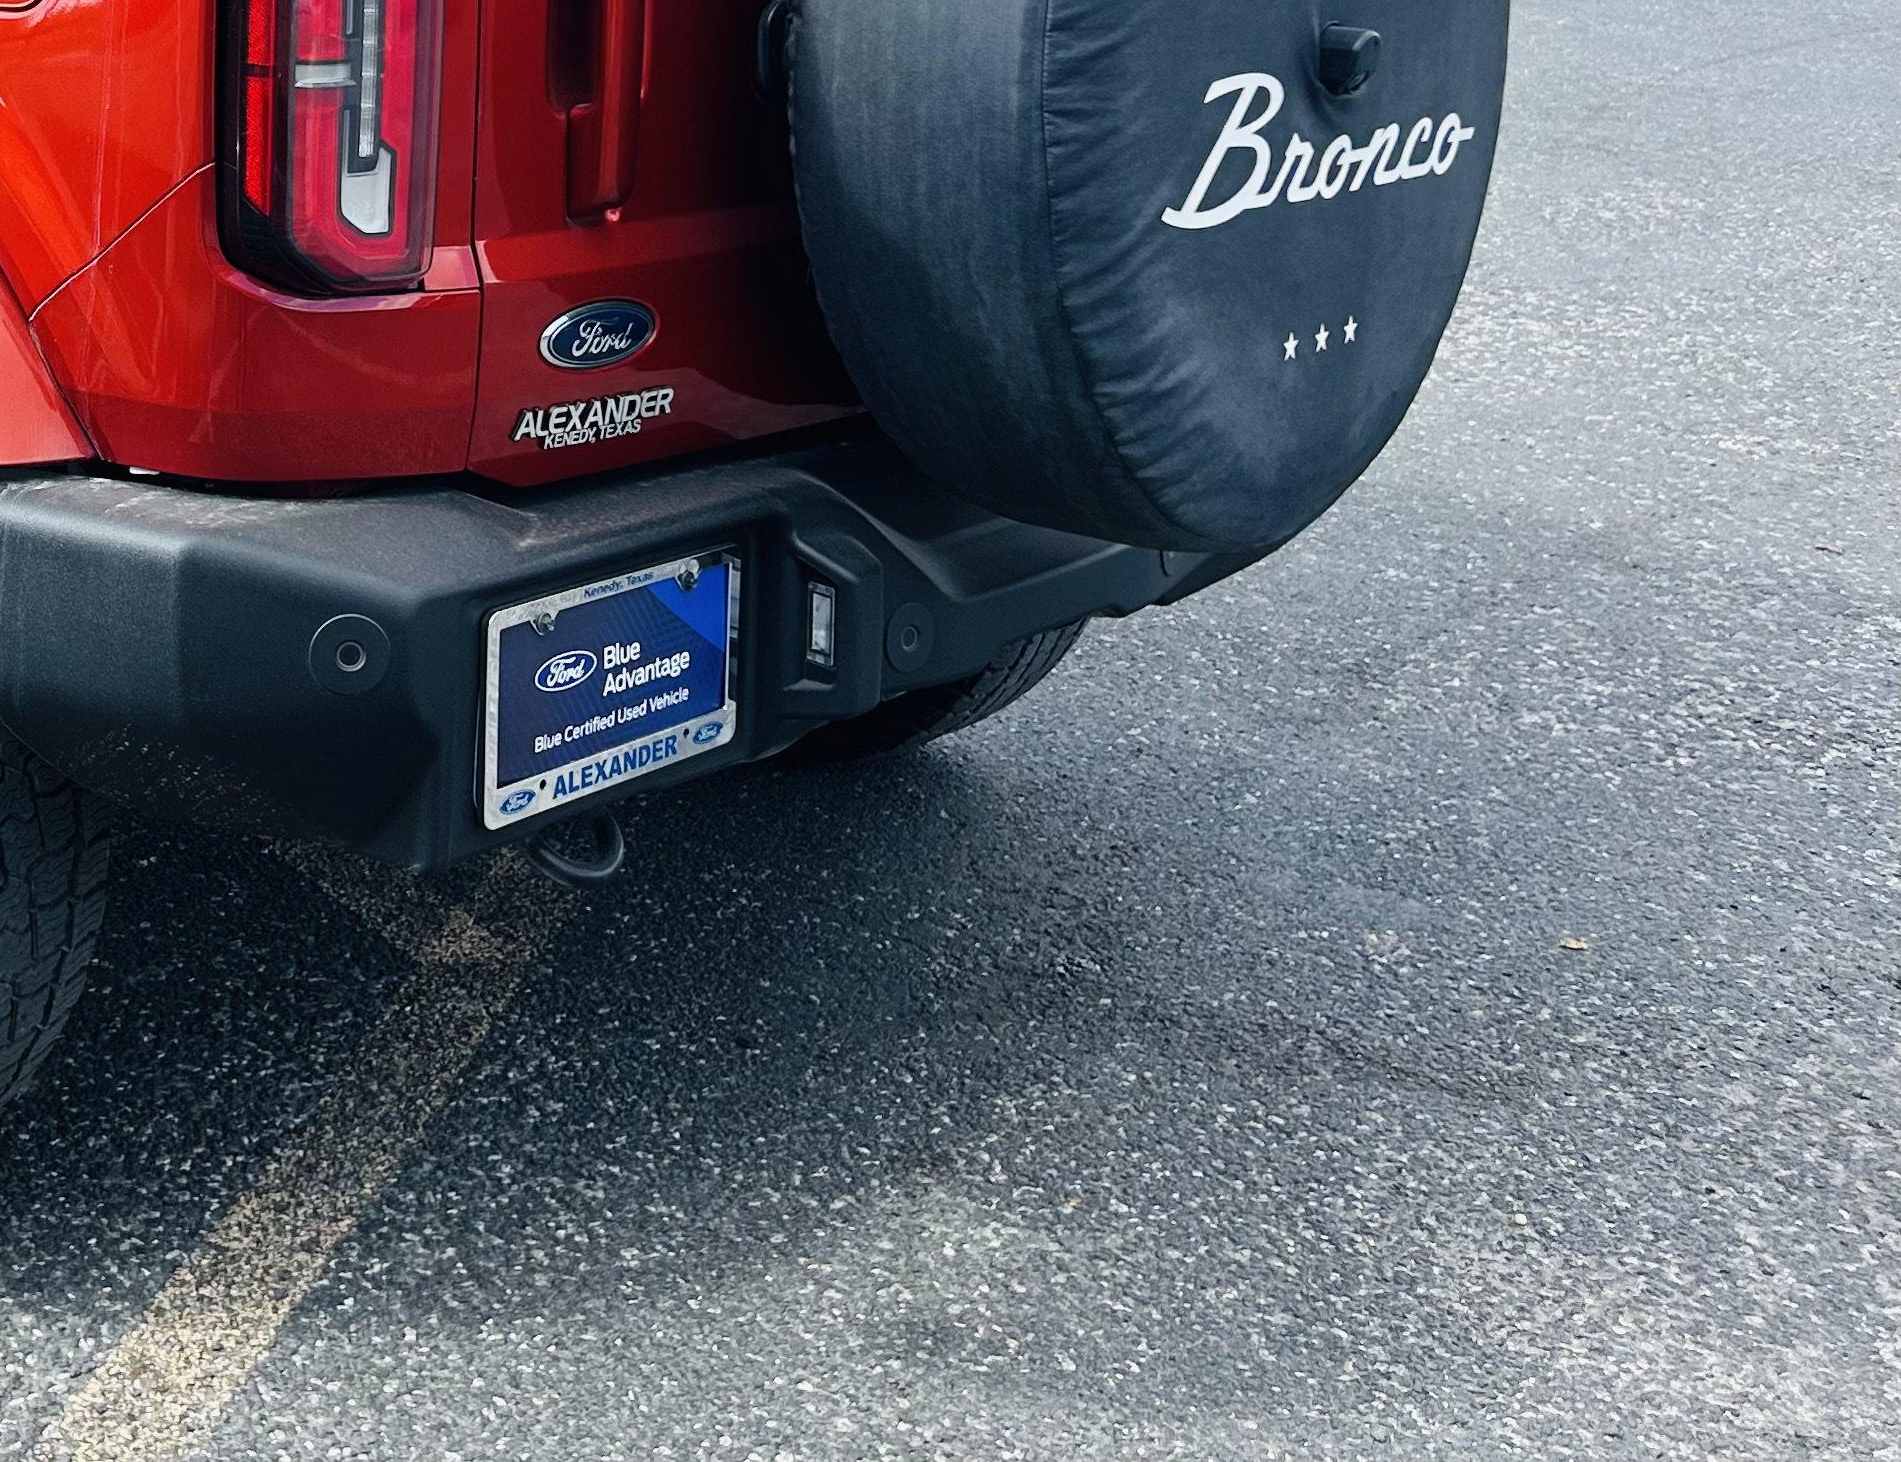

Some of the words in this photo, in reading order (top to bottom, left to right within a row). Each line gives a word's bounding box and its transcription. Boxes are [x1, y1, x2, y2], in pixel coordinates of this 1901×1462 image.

[1160, 72, 1476, 230] Bronco
[572, 316, 634, 357] Ford
[513, 388, 675, 441] ALEXANDER
[543, 426, 597, 450] KENEDY,
[598, 419, 642, 440] TEXAS
[625, 572, 654, 586] Texas
[546, 657, 585, 686] Ford
[602, 650, 691, 697] Advantage
[603, 641, 641, 670] Blue
[533, 734, 562, 754] Blue
[563, 713, 616, 742] Certified
[617, 699, 647, 724] Used
[649, 686, 689, 712] Vehicle
[552, 734, 678, 799] ALEXANDER
